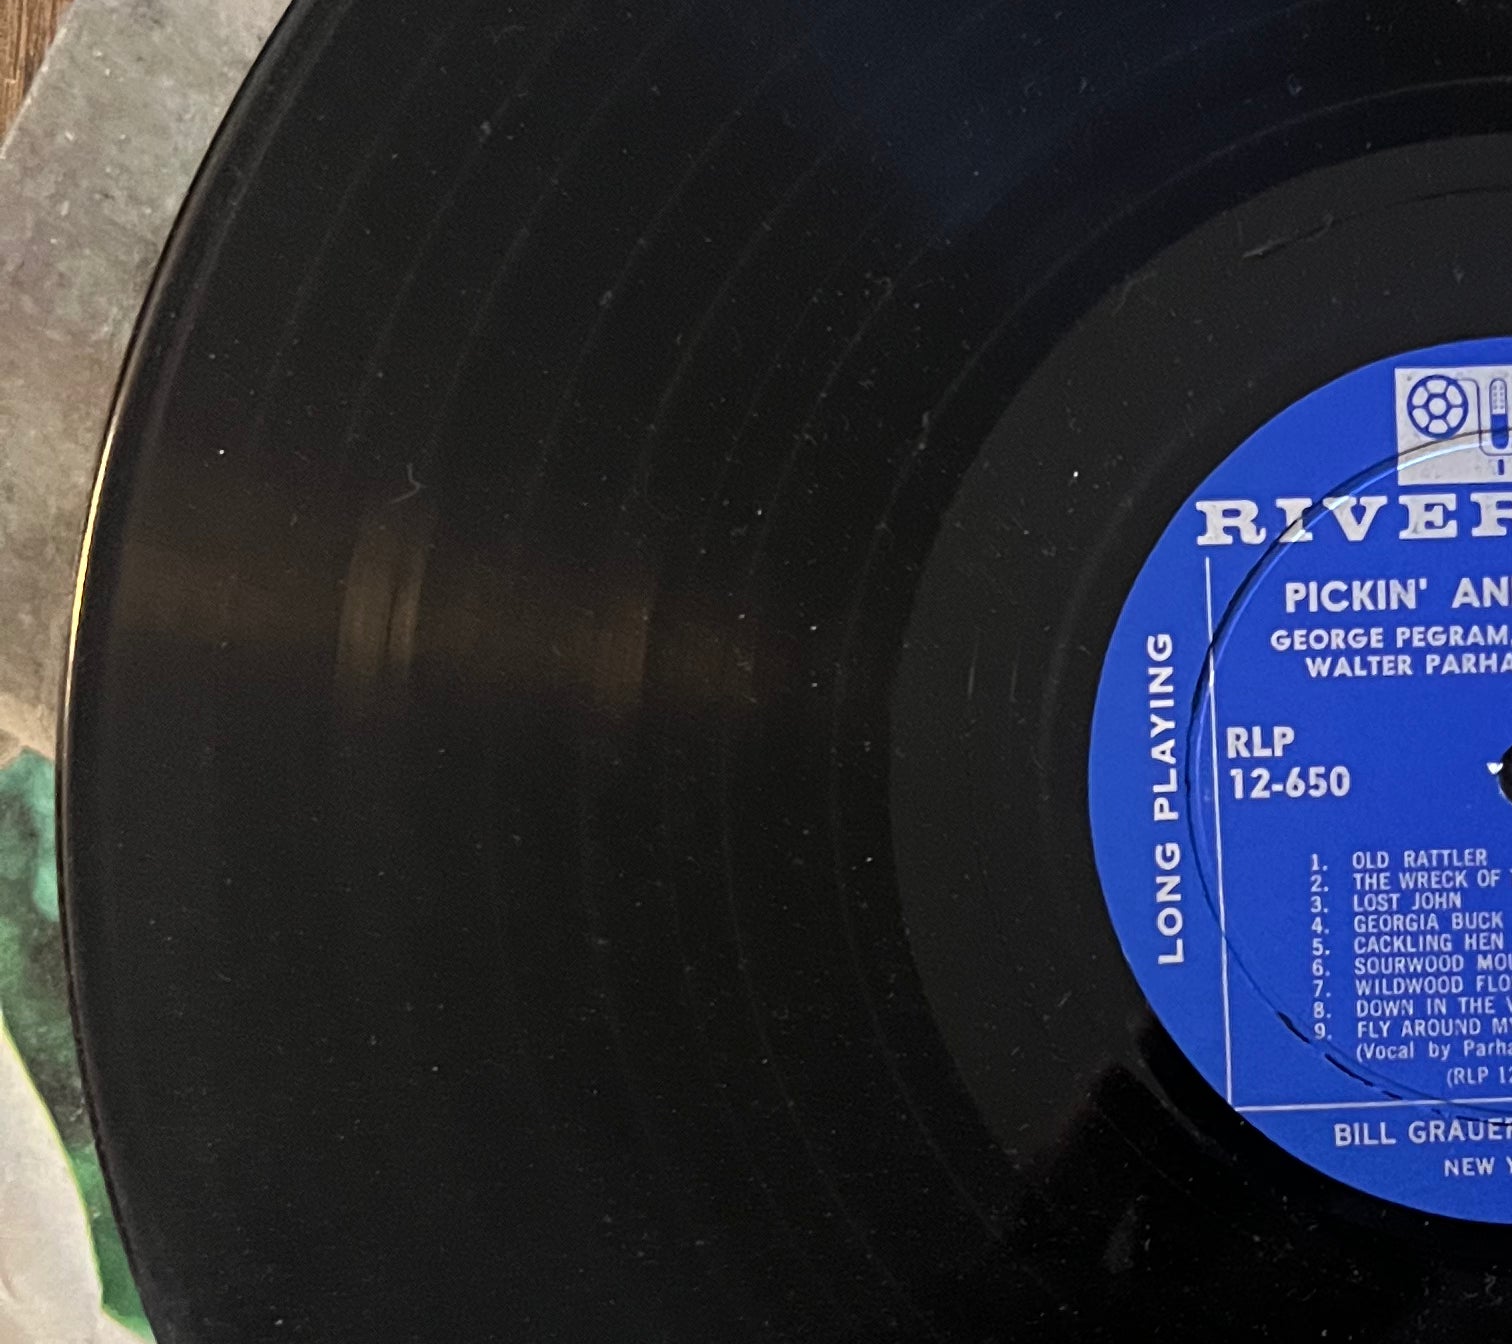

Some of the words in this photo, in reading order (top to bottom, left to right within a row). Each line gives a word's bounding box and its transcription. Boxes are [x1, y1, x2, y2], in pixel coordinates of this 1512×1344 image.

[1285, 577, 1428, 613] PICKIN'
[1270, 627, 1384, 652] GEORGE
[1305, 654, 1414, 678] WALTER
[1147, 632, 1179, 822] PLAYING
[1226, 725, 1295, 759] RLP
[1229, 765, 1351, 800] 12-650
[1311, 853, 1328, 871] 1.
[1352, 851, 1389, 870] OLD
[1403, 848, 1487, 868] RATTLER
[1310, 874, 1329, 892] 2.
[1353, 872, 1391, 891] THE
[1399, 869, 1468, 890] WRECK
[1477, 869, 1500, 887] OF
[1155, 842, 1185, 966] LONG
[1310, 895, 1328, 913] 3.
[1353, 893, 1401, 912] LOST
[1411, 891, 1462, 910] JOHN
[1311, 916, 1329, 934] 4.
[1353, 913, 1439, 933] GEORGIA
[1451, 911, 1503, 930] BUCK
[1312, 937, 1330, 956] 5.
[1353, 933, 1452, 954] CACKLING
[1464, 932, 1504, 951] HEN
[1312, 958, 1330, 977] 6.
[1354, 954, 1464, 975] SOURWOOD
[1313, 979, 1331, 997] 7.
[1355, 975, 1463, 996] WILDWOOD
[1313, 1001, 1331, 1019] 8.
[1356, 999, 1414, 1018] DOWN
[1427, 998, 1447, 1015] IN
[1458, 996, 1495, 1014] THE
[1314, 1022, 1332, 1039] 9.
[1357, 1020, 1391, 1038] FLY
[1401, 1018, 1481, 1037] AROUND
[1356, 1041, 1414, 1063] (Vocal
[1428, 1041, 1450, 1061] by
[1447, 1066, 1489, 1086] (RLP
[1334, 1121, 1397, 1147] BILL
[1444, 1157, 1495, 1177] NEW
